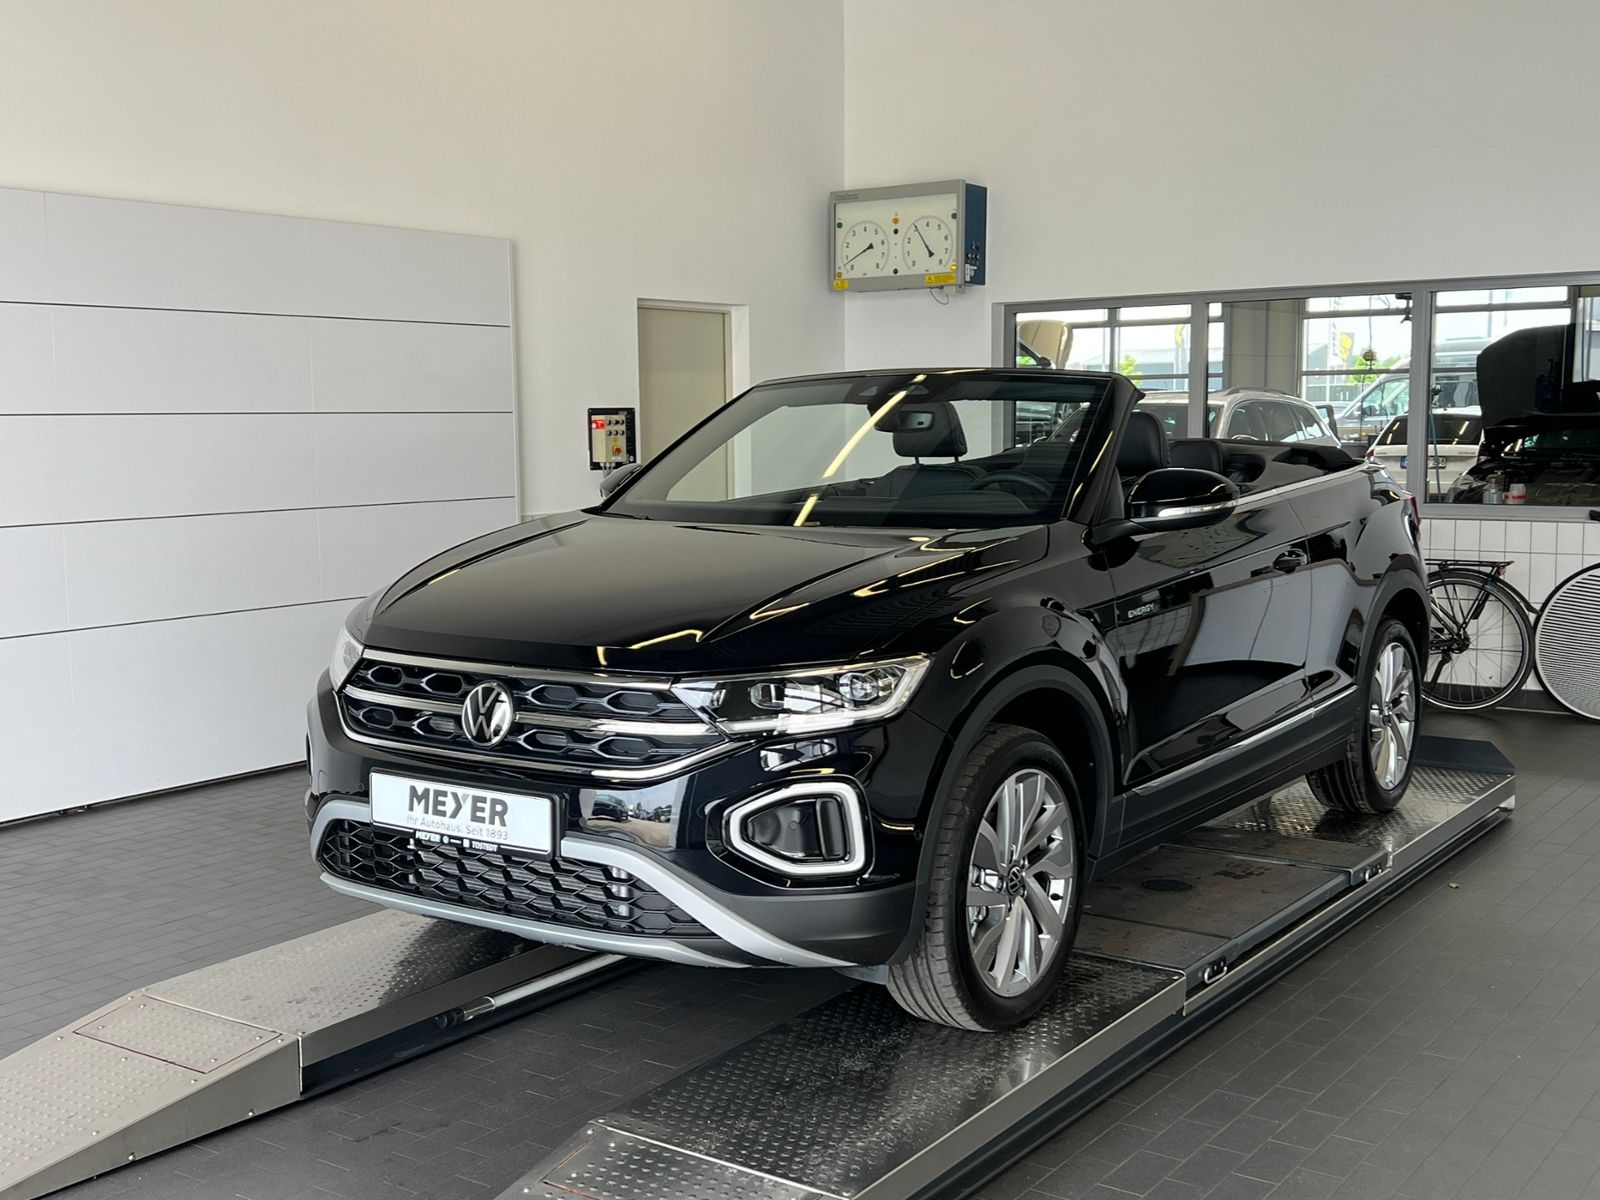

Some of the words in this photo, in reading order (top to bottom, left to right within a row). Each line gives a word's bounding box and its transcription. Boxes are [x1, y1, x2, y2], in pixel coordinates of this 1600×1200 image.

[1127, 602, 1154, 618] ENERGY
[408, 785, 508, 827] MEYER
[407, 816, 418, 825] Ihr
[420, 819, 464, 833] Autohaus.
[465, 825, 483, 835] Seit
[486, 828, 508, 840] 1893
